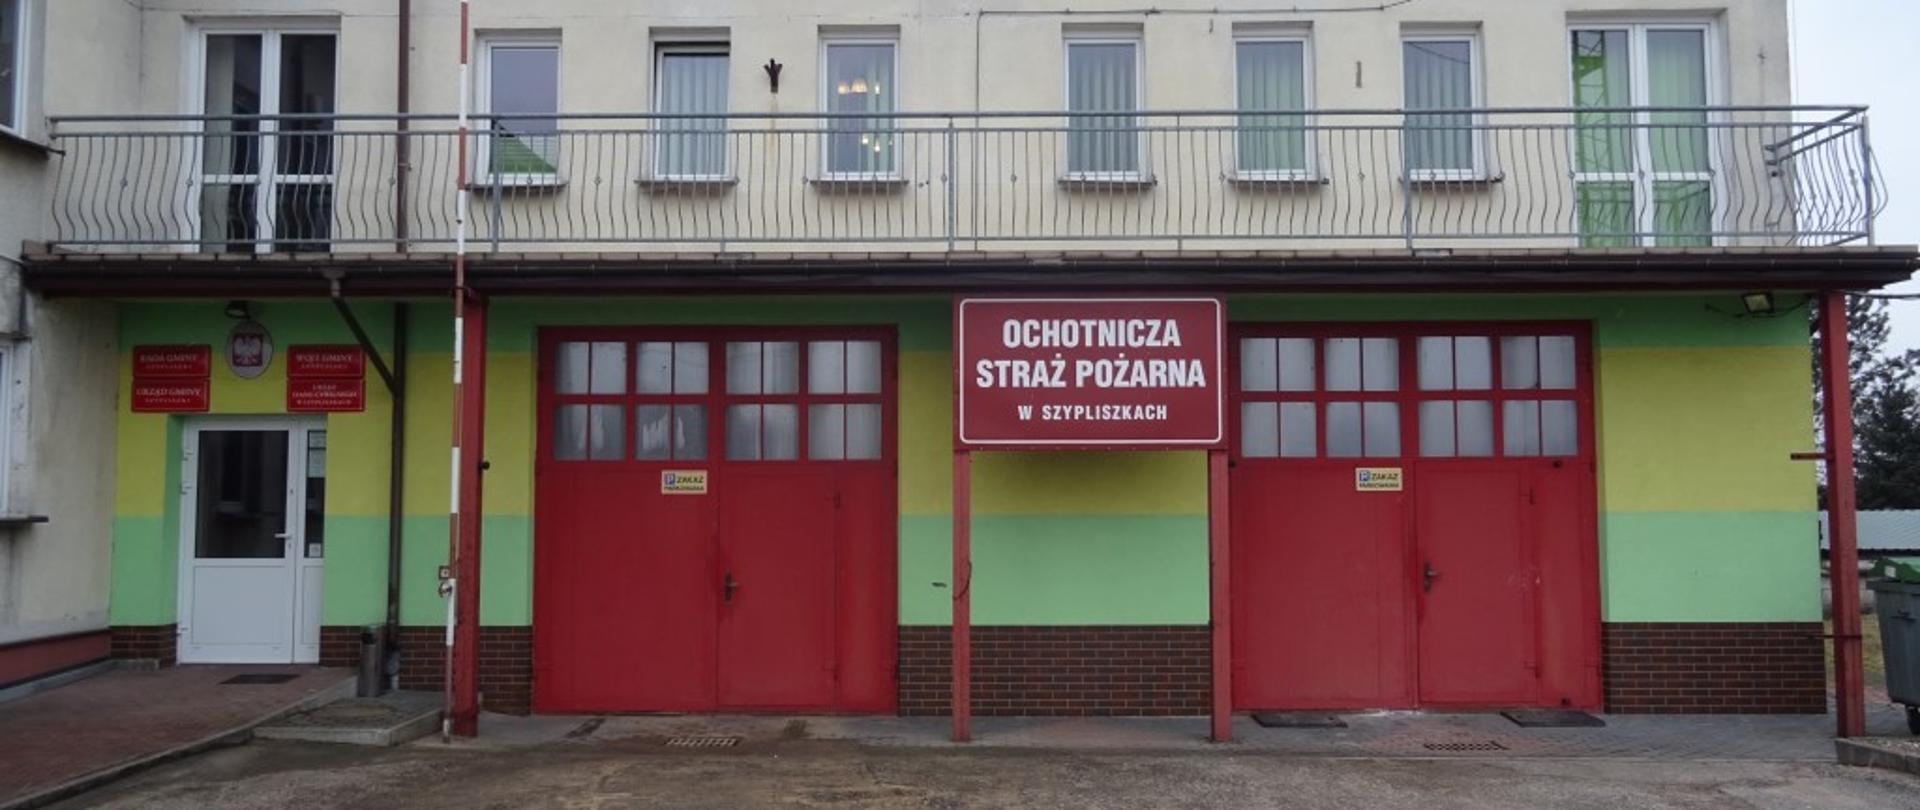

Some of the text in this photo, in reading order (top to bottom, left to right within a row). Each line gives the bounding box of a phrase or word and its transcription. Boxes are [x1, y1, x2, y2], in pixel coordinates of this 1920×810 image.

[1003, 319, 1181, 348] OCHOTNICZA
[976, 353, 1206, 388] STRAŻ POŻARNA
[1018, 404, 1167, 420] W SZYPLISZKACH
